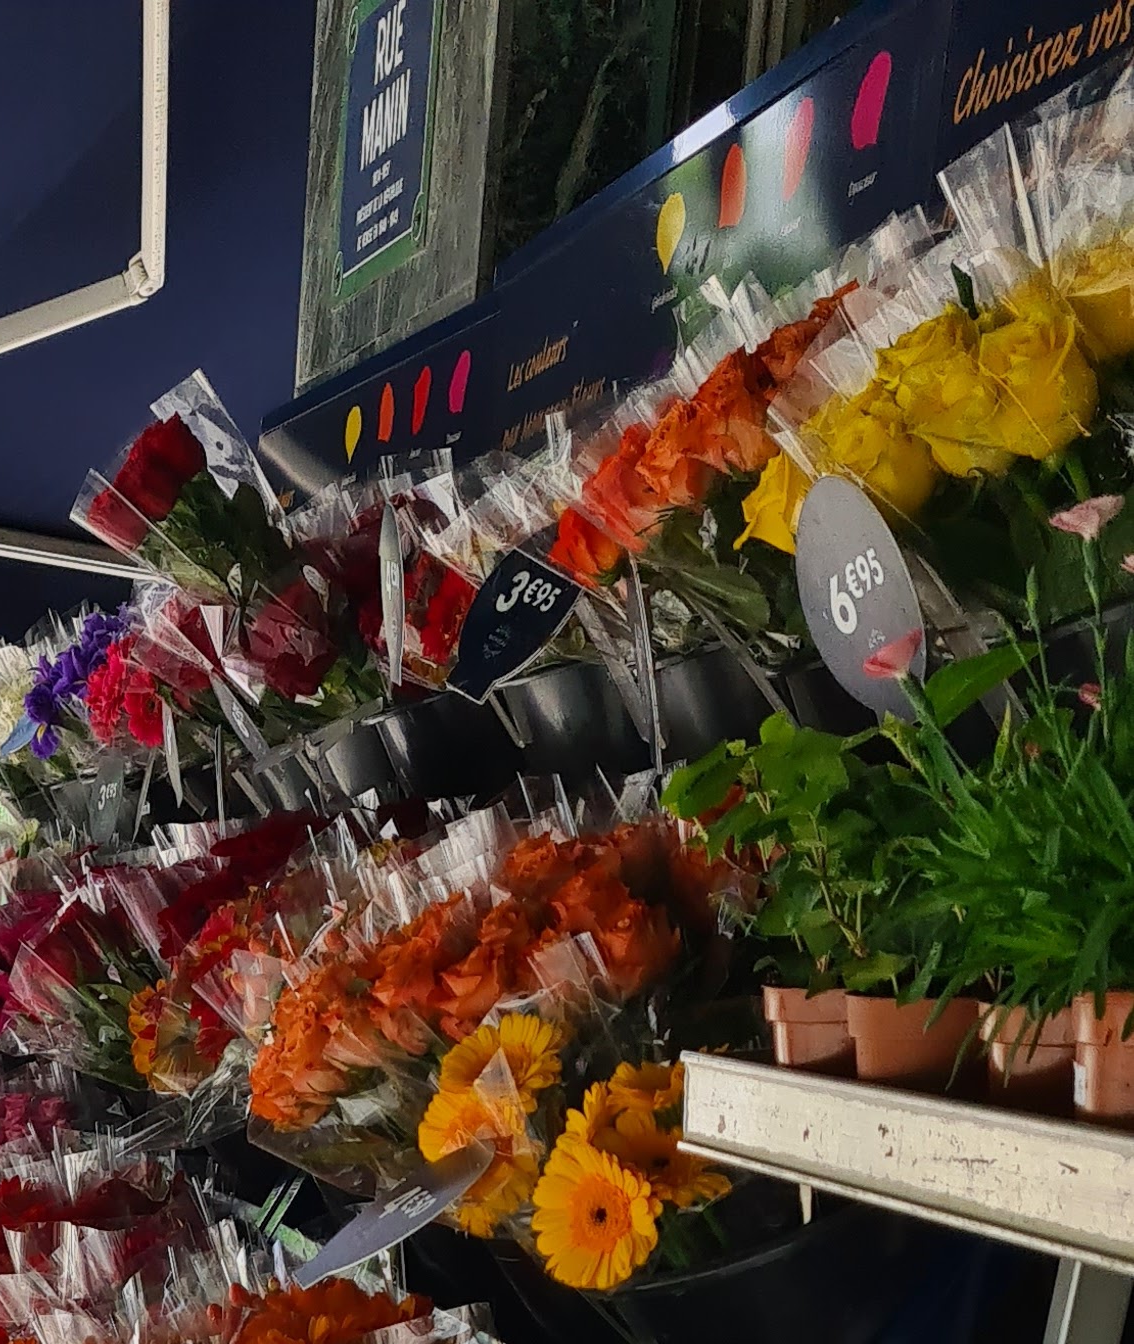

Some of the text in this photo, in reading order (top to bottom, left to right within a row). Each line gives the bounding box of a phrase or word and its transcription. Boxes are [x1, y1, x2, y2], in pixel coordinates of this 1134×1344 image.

[374, 0, 407, 86] RUE
[953, 0, 1134, 125] Choisissez vos
[360, 68, 411, 171] MANIN
[507, 336, 569, 392] Les couleurs
[495, 570, 562, 613] 3€95
[829, 547, 885, 636] 6€95
